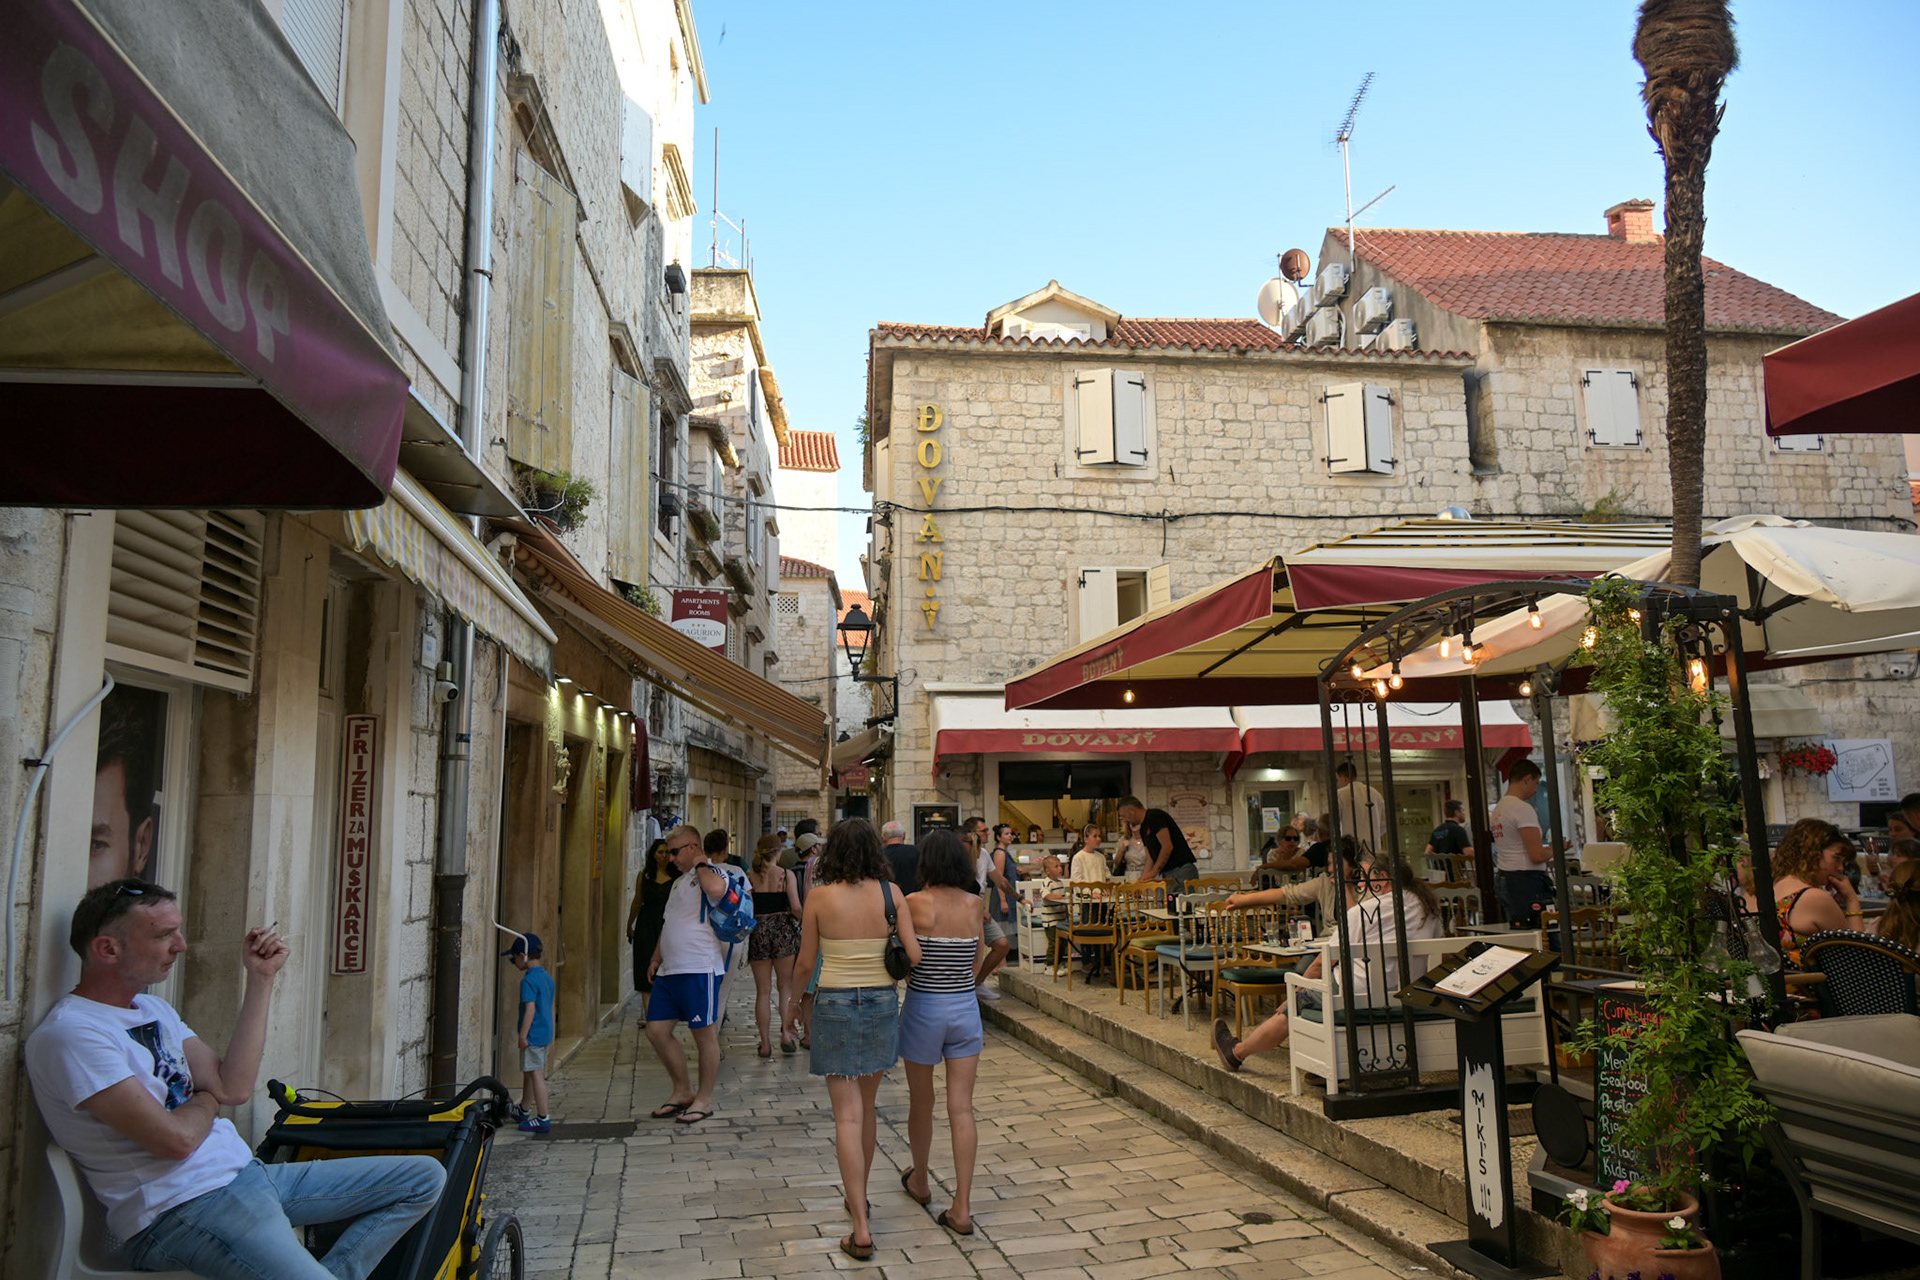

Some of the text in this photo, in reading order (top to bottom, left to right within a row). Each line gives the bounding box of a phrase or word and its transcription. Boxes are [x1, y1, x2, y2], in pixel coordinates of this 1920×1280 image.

[31, 40, 290, 363] SHOP
[350, 724, 369, 818] FRIZER
[349, 821, 366, 834] ZA
[1600, 1071, 1652, 1096] Seafood
[1600, 1093, 1634, 1113] Pasta
[1472, 1090, 1487, 1175] MIKI'S
[1603, 1157, 1627, 1178] Kids
